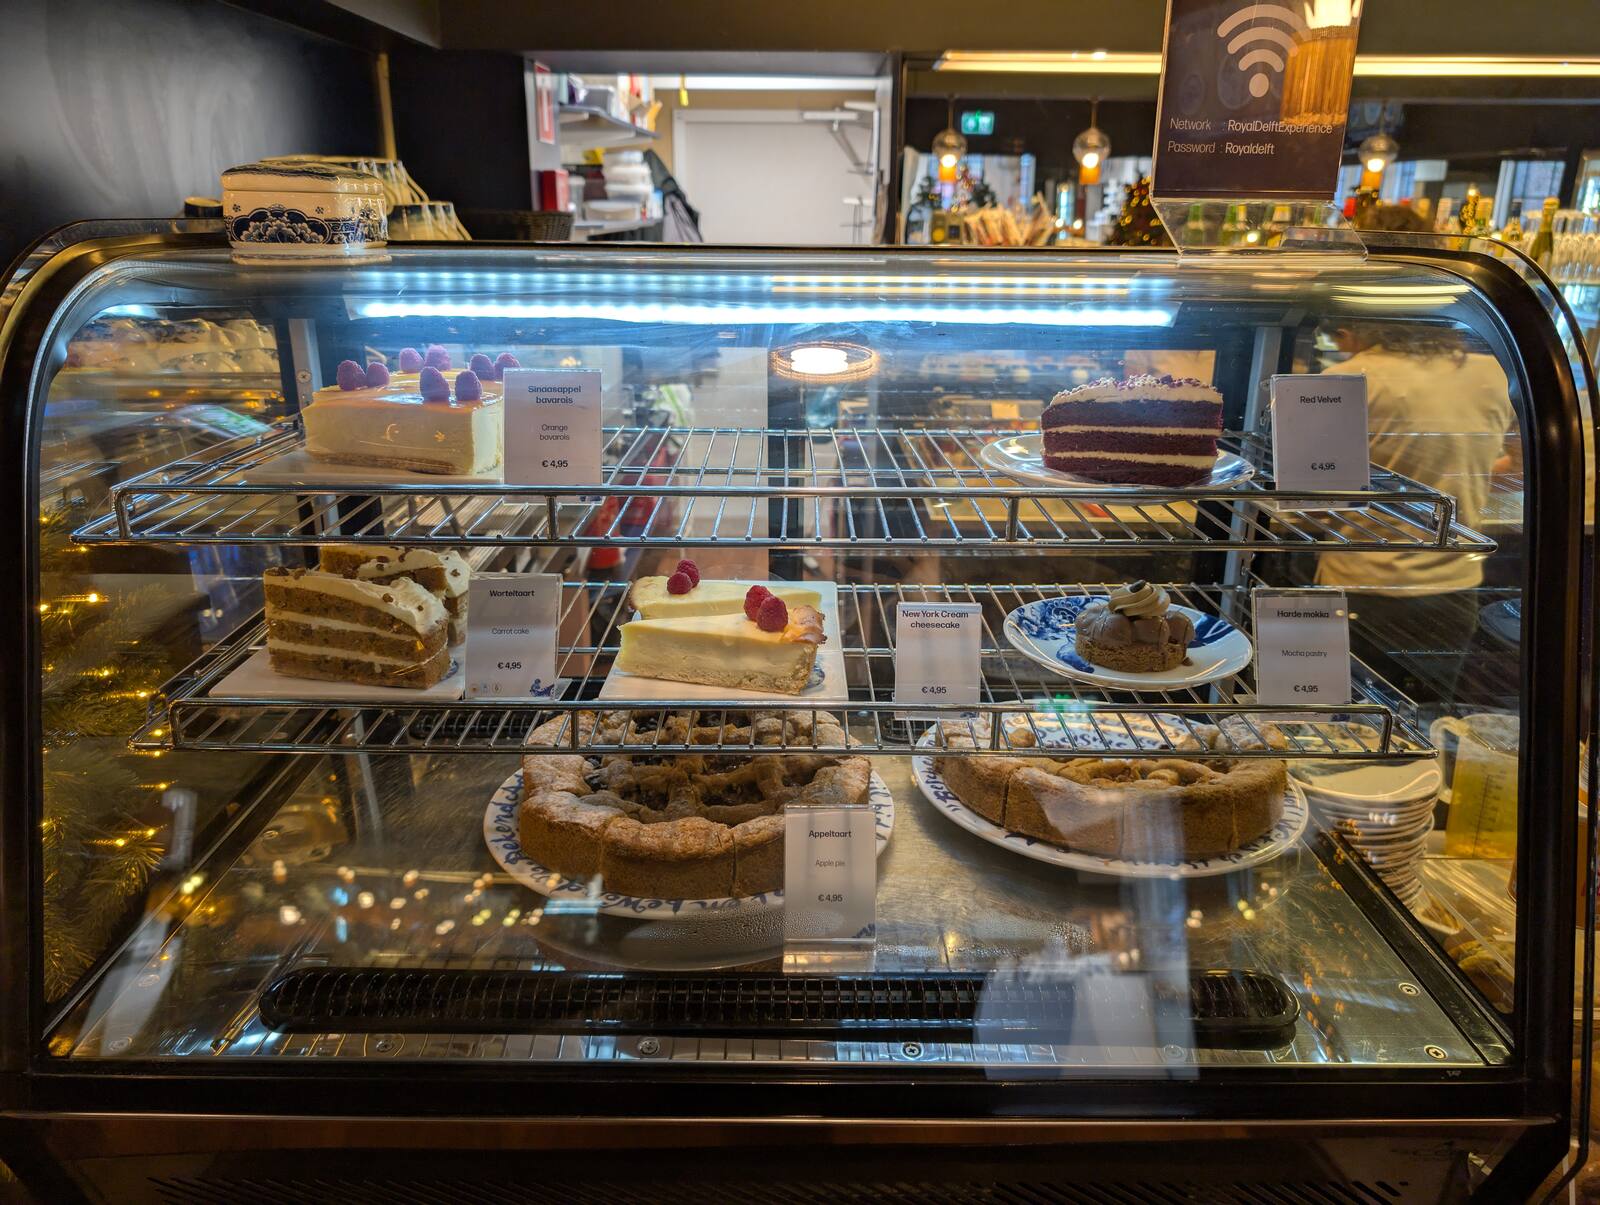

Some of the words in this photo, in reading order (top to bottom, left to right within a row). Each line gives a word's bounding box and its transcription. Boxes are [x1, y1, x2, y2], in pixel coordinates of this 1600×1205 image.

[1169, 117, 1212, 131] Network
[1227, 118, 1334, 136] RoyalDelftExperience
[1167, 140, 1216, 154] Password
[1224, 141, 1275, 157] Royaldelft
[527, 385, 582, 395] Sinaasappel
[1299, 395, 1316, 404] Red
[1317, 395, 1342, 404] Velvet
[541, 423, 568, 433] Orange
[550, 459, 569, 469] 4,95
[1318, 462, 1336, 471] 4,95
[489, 589, 535, 598] Worteltaart
[902, 610, 920, 618] New
[921, 610, 940, 618] York
[940, 610, 969, 618] Cream
[1276, 609, 1302, 618] Harde
[1302, 609, 1330, 618] mokka
[910, 621, 960, 629] cheesecake
[491, 627, 513, 635] Carrot
[514, 627, 530, 635] cake
[1281, 649, 1305, 657] Mocha
[1305, 649, 1328, 658] pastry
[505, 661, 522, 670] 4,95
[929, 686, 947, 695] 4,95
[1301, 684, 1319, 693] 4,95
[808, 829, 852, 839] Appeltaart
[815, 858, 834, 868] Apple
[825, 893, 843, 903] 4,95
